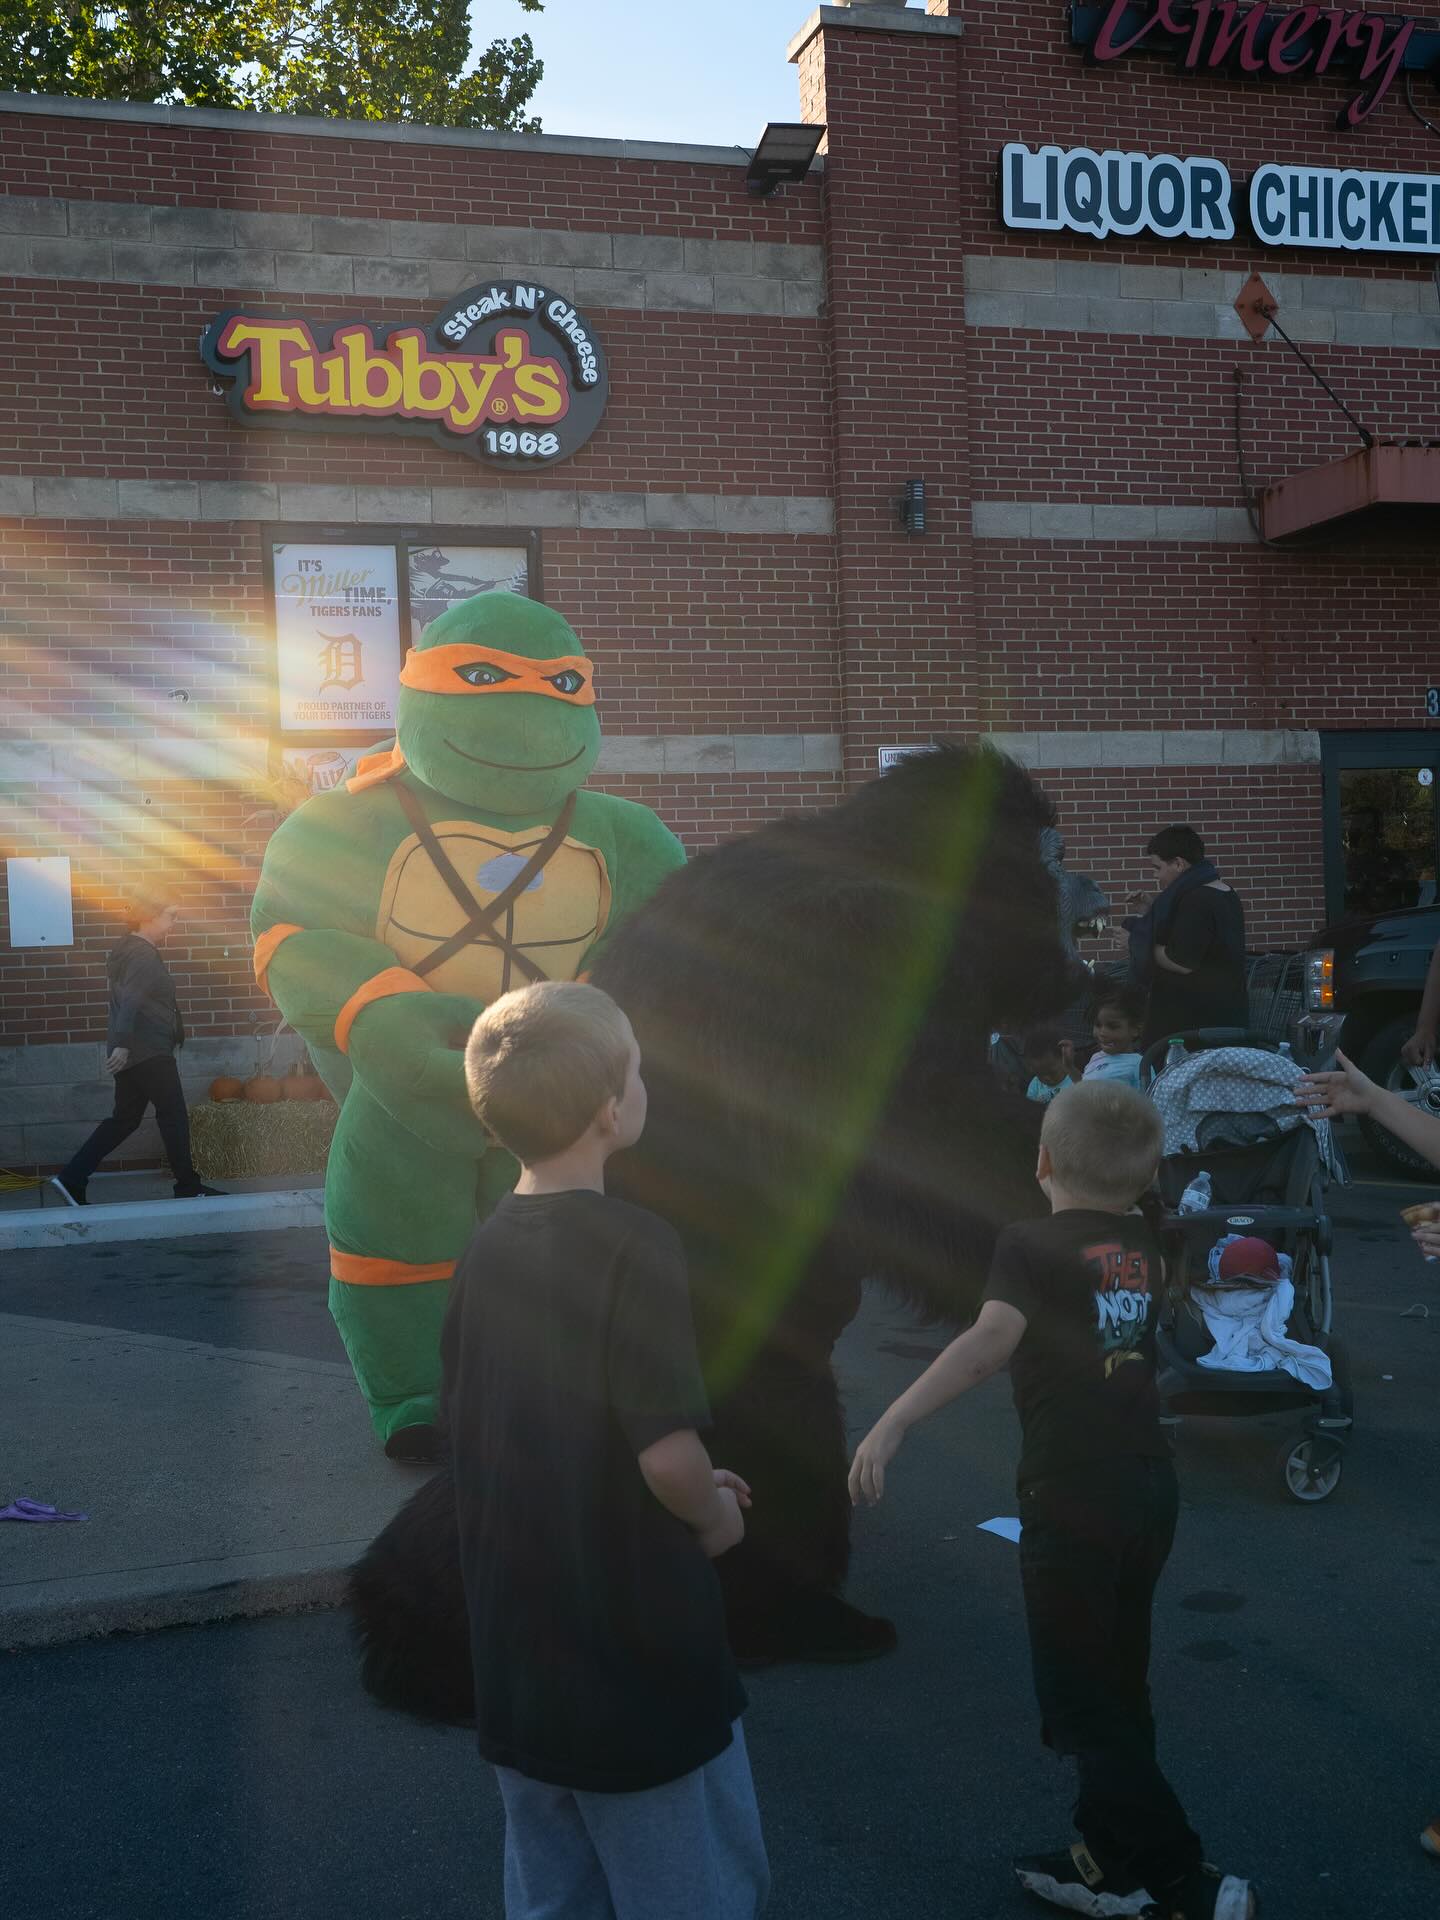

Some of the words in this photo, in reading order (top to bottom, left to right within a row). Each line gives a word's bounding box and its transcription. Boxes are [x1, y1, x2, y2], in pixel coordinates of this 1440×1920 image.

[1011, 152, 1227, 230] LIQUOR
[443, 287, 511, 341] Steak
[514, 285, 545, 310] N'
[547, 300, 598, 383] Cheese
[226, 323, 563, 427] Tubby's
[486, 430, 560, 456] 1968
[298, 559, 323, 572] IT'S
[281, 567, 375, 608] Miller
[342, 586, 392, 605] TIME,
[310, 606, 351, 617] TIGERS
[352, 606, 382, 617] FANS
[295, 711, 320, 720] YOUR
[320, 711, 359, 720] DETROIT
[360, 711, 392, 720] TIGERS
[298, 702, 331, 711] PROUD
[331, 702, 373, 711] PARTNER
[374, 702, 387, 711] OF
[1095, 1289, 1152, 1330] NOT
